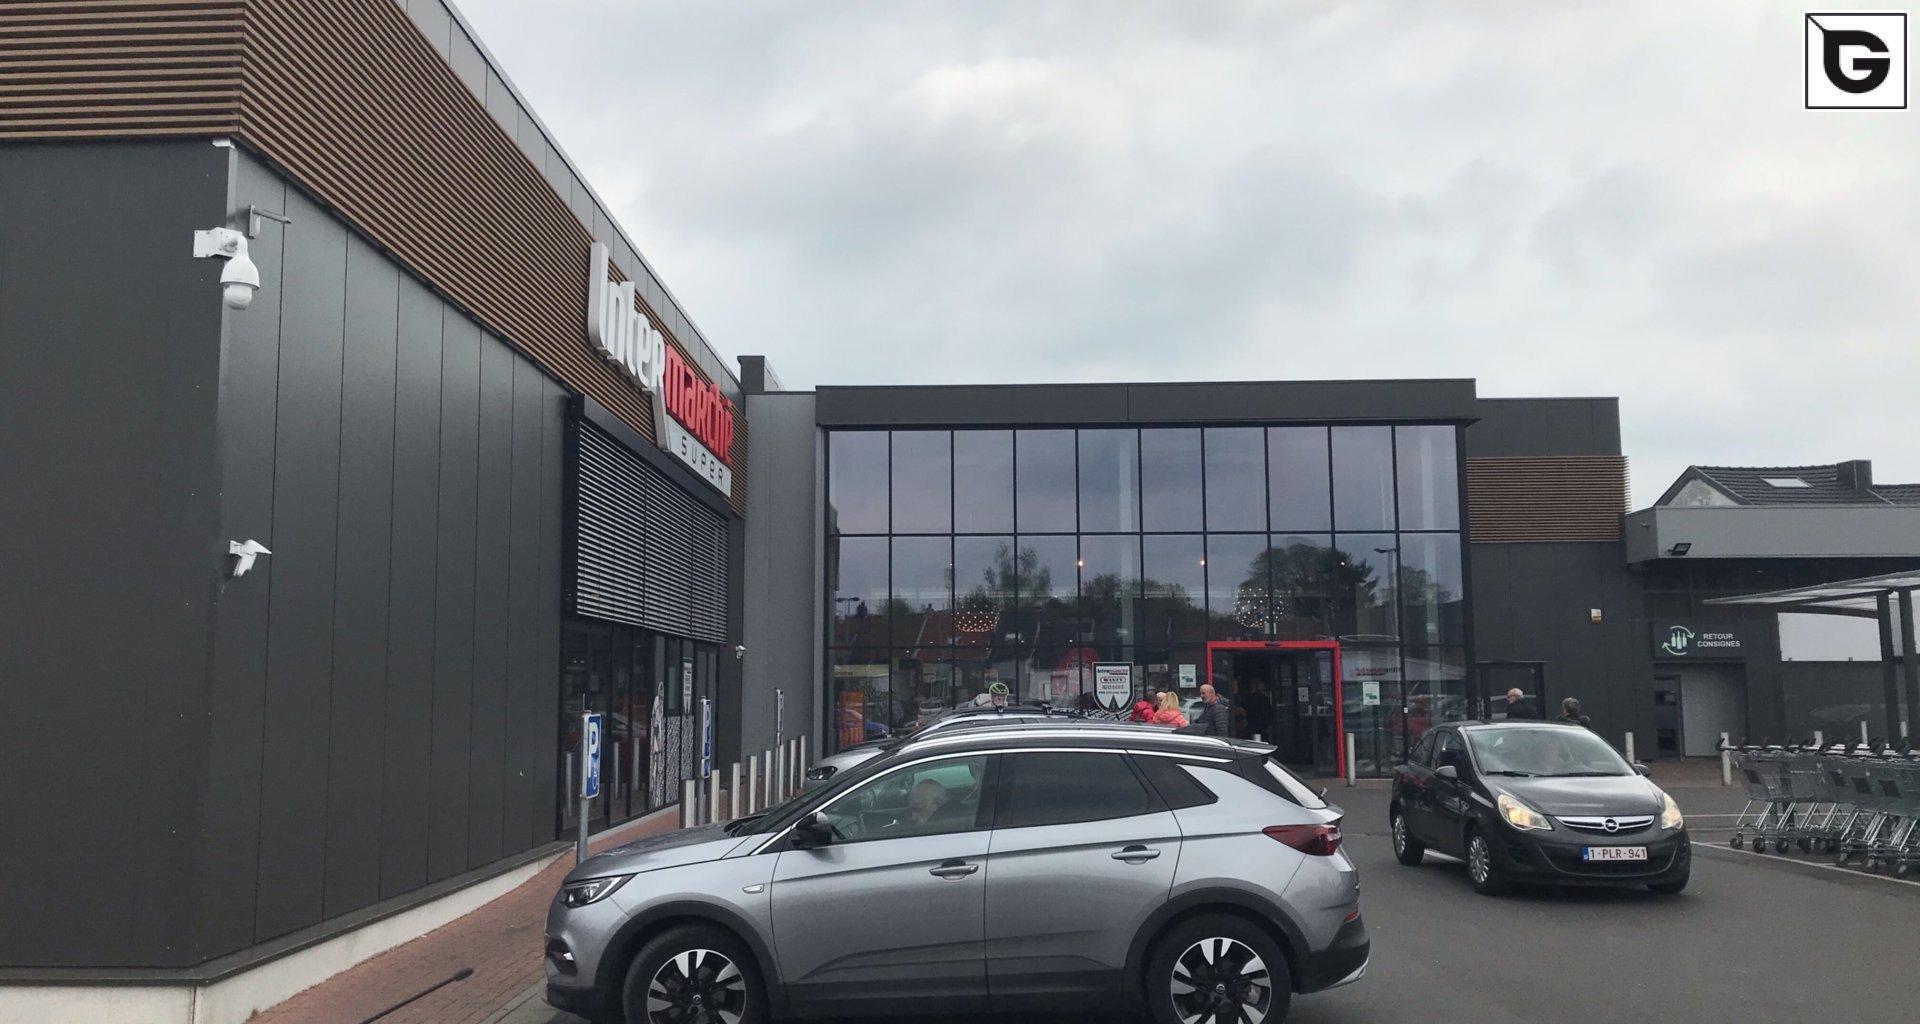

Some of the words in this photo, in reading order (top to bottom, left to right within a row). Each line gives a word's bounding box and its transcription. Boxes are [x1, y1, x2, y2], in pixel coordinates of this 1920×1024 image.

[681, 435, 724, 487] SUPER
[1697, 640, 1741, 648] CONSIGNES
[587, 722, 598, 778] P
[1590, 848, 1646, 859] 1-PLR-941
